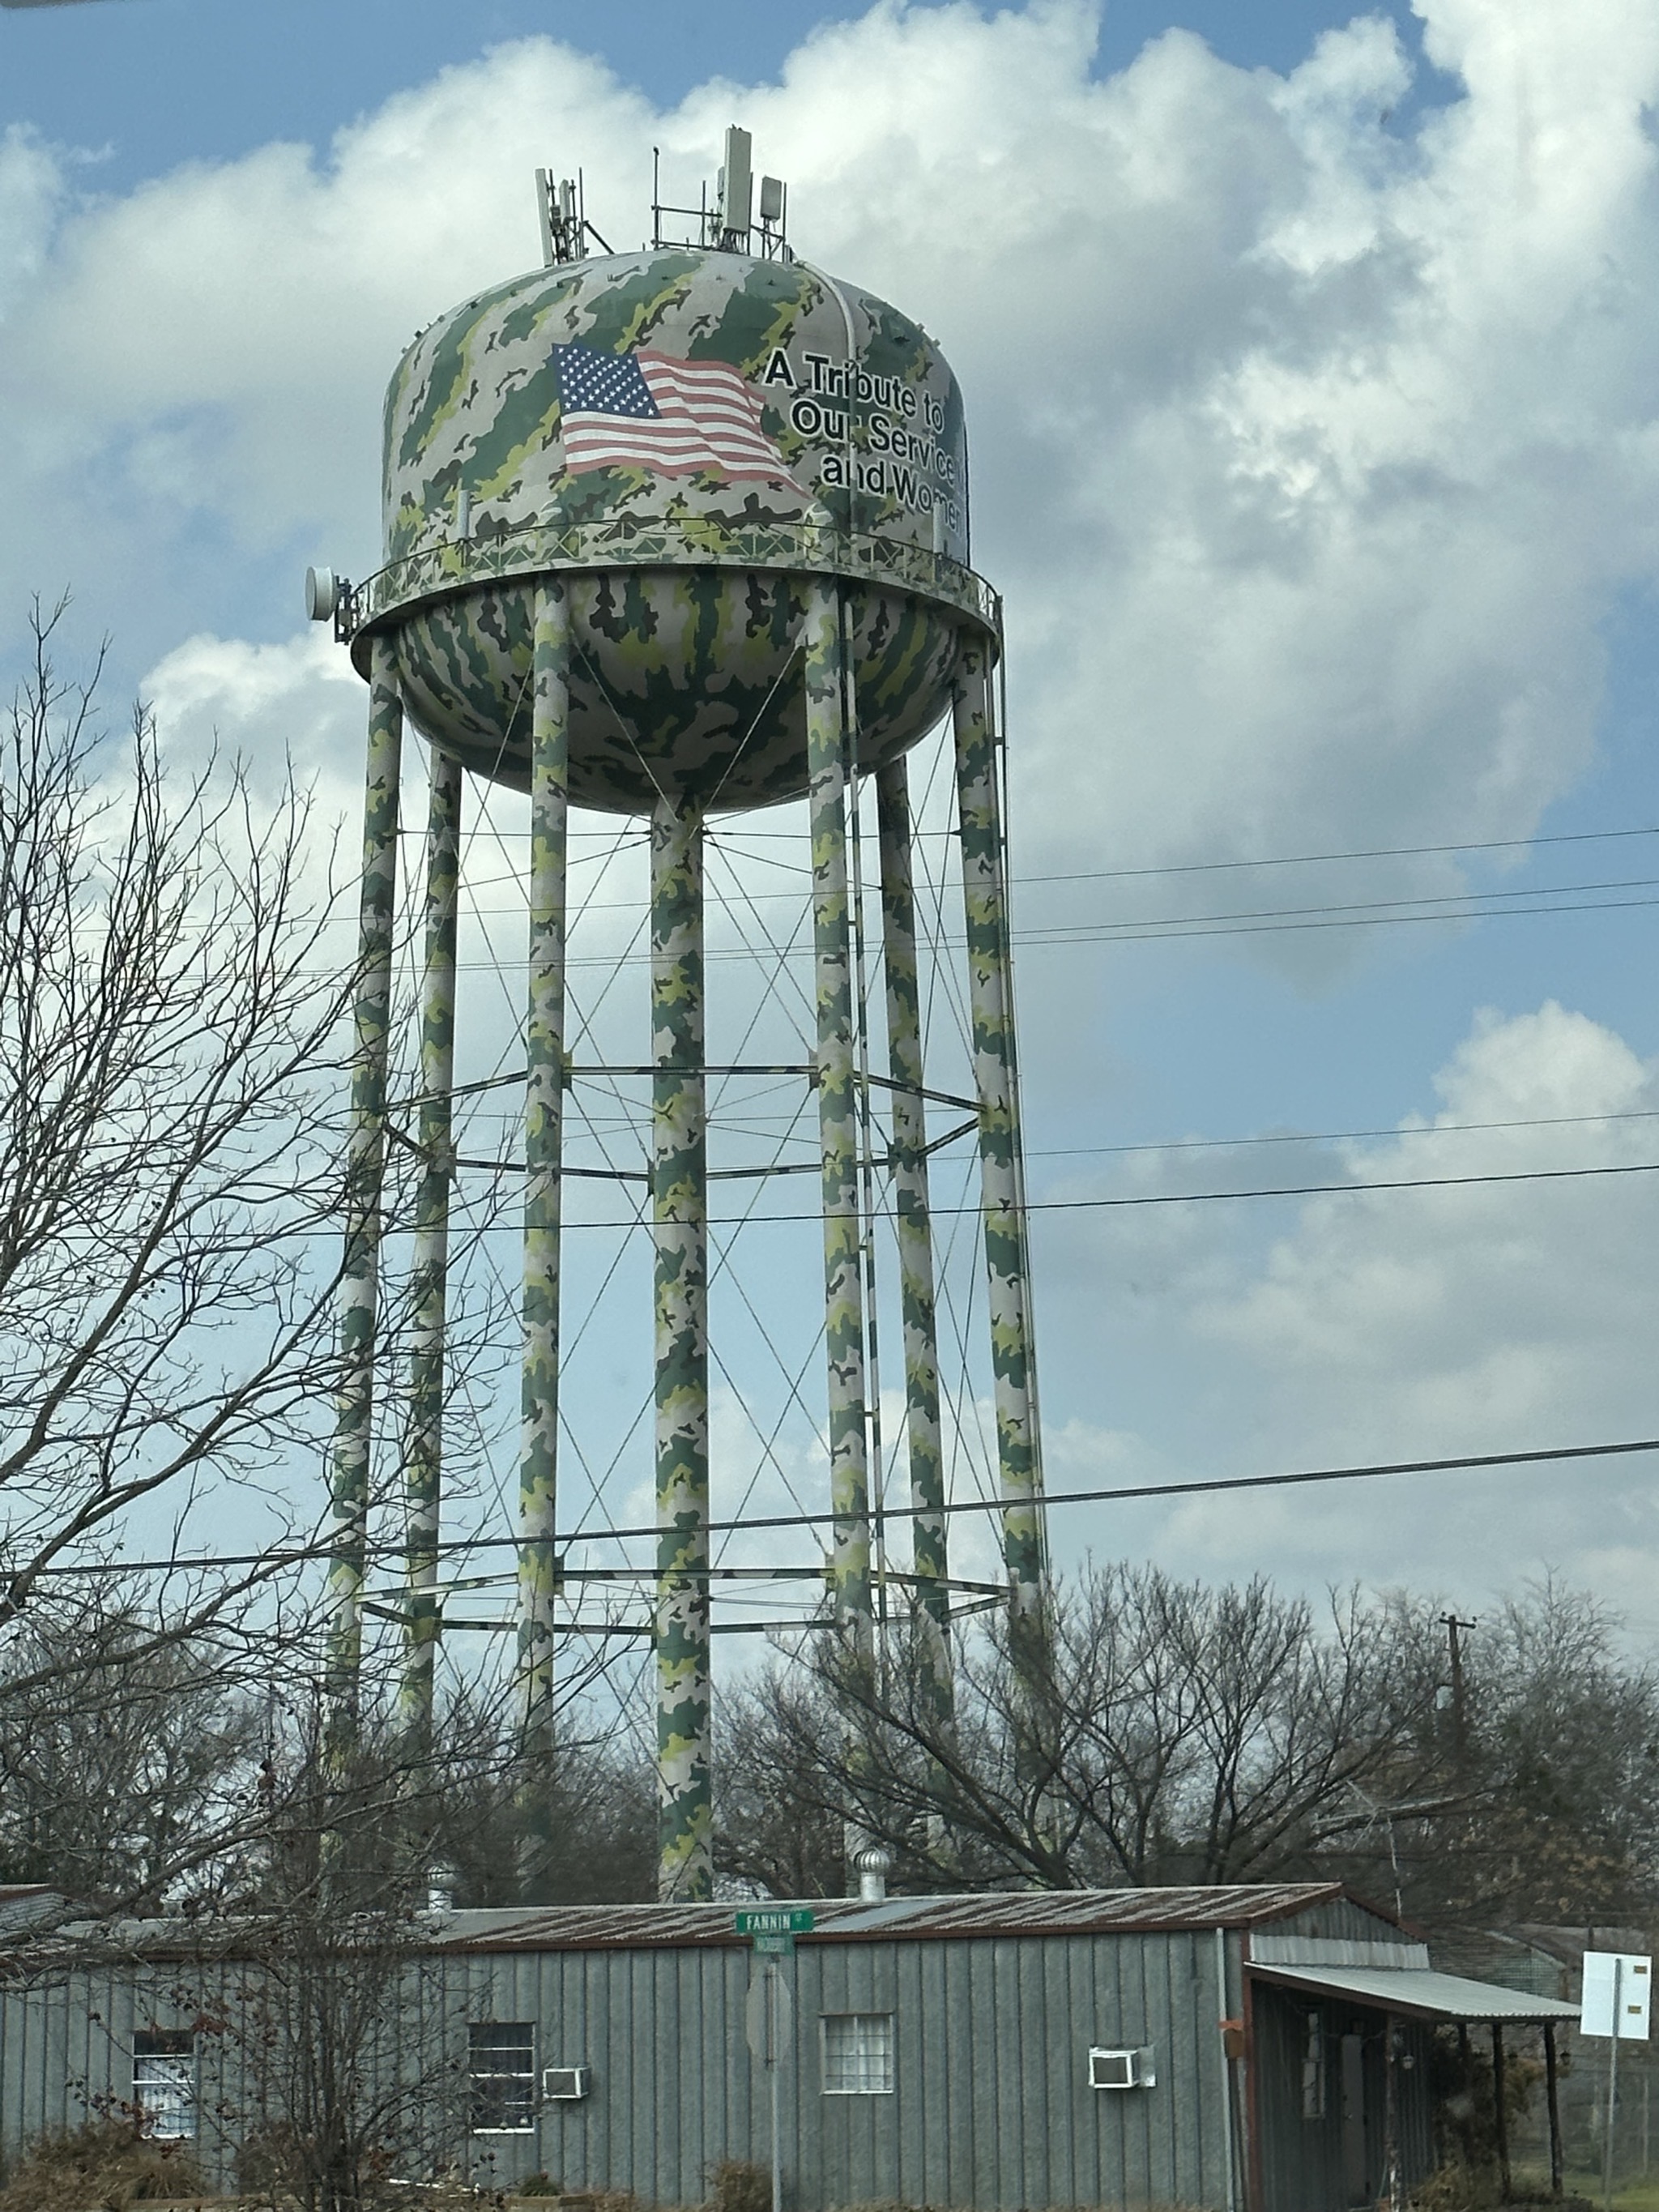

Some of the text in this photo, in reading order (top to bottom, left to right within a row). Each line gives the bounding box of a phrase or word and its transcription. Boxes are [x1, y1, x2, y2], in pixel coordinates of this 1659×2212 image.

[762, 347, 945, 435] A Tribute to
[821, 454, 889, 497] and
[746, 1914, 791, 1930] FANNIN
